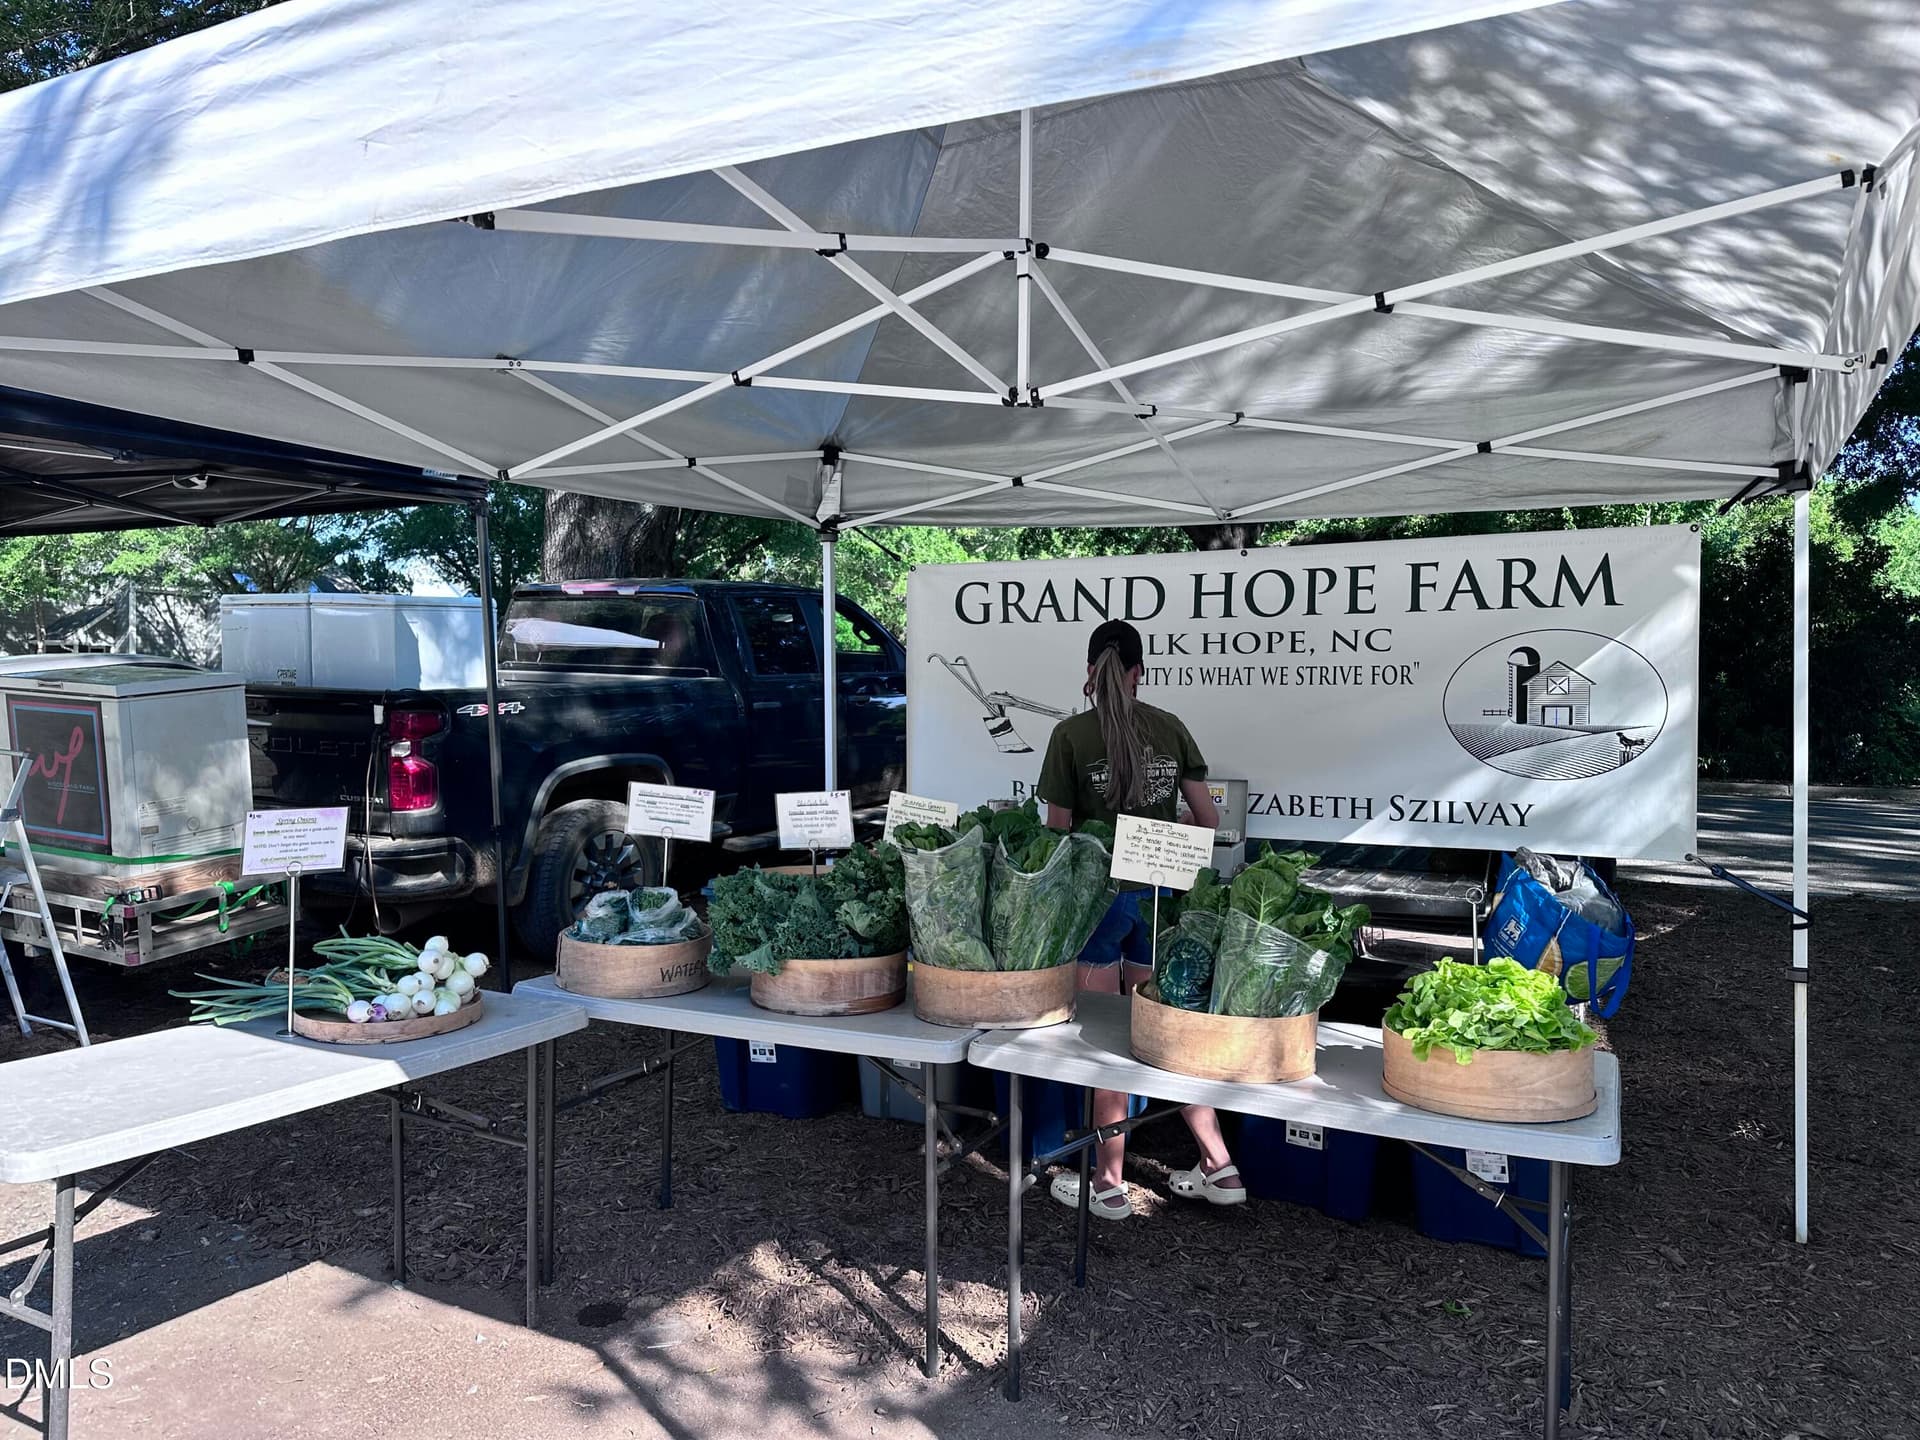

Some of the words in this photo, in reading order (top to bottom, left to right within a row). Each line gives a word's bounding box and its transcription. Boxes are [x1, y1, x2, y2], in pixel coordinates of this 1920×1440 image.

[955, 575, 1167, 624] GRAND
[1189, 564, 1377, 620] HOPE
[1404, 551, 1625, 613] FARM
[1149, 633, 1191, 657] LK
[1201, 630, 1316, 658] HOPE,
[1329, 628, 1393, 654] NC
[1178, 666, 1194, 686] IS
[1199, 666, 1256, 686] WHAT
[1261, 666, 1290, 686] WE
[1295, 664, 1364, 686] STRIVE
[1370, 661, 1421, 685] FOR"
[1248, 792, 1374, 820] ZABETH
[1388, 793, 1536, 828] SZILVAY
